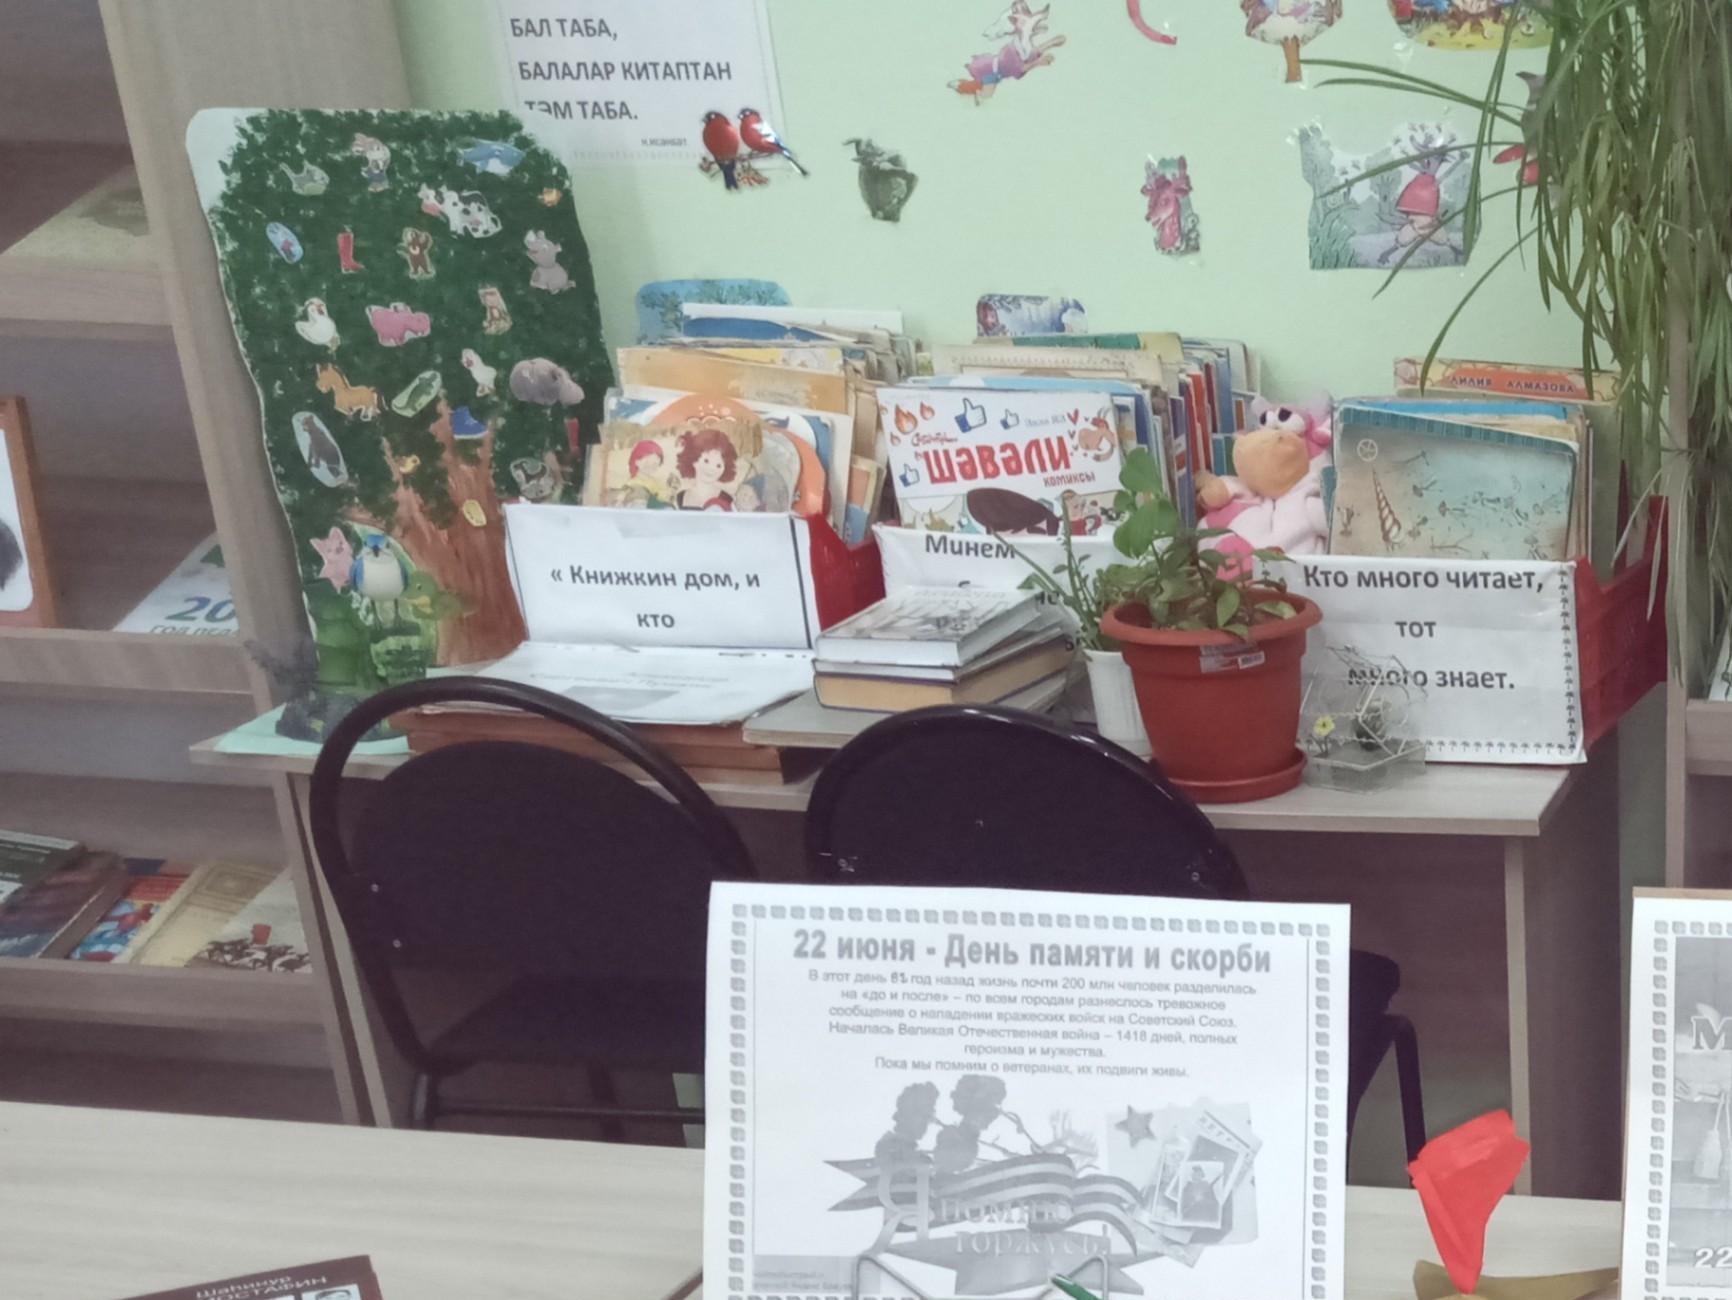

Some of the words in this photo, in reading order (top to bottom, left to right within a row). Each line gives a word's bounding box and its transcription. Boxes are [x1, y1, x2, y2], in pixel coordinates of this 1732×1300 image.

[510, 18, 551, 38] БАЛ
[556, 18, 618, 41] ТАБА,
[518, 62, 615, 81] БАЛАЛАР
[622, 62, 732, 81] КИТАПТАН
[576, 100, 638, 120] ТАБА.
[925, 534, 1016, 560] Минем
[569, 565, 676, 588] Книжкин
[684, 571, 740, 591] дом,
[746, 573, 761, 588] и
[1303, 564, 1348, 589] Кто
[1357, 569, 1439, 589] много
[1446, 570, 1544, 593] читает,
[636, 613, 675, 629] кто
[1395, 619, 1436, 638] тот
[1435, 669, 1515, 690] знает.
[793, 929, 827, 959] 22
[837, 936, 915, 962] июня
[944, 932, 1019, 968] День
[1029, 942, 1134, 971] памяти
[1145, 946, 1160, 970] и
[1171, 943, 1271, 978] скорби
[808, 969, 819, 981] В
[822, 971, 850, 983] этот
[854, 972, 886, 986] день
[911, 974, 932, 988] год
[935, 975, 975, 990] назад
[978, 976, 1018, 989] жизнь
[1021, 977, 1058, 989] почти
[1062, 977, 1085, 991] 200
[1089, 979, 1115, 991] млн
[1118, 980, 1170, 993] человек
[1174, 981, 1257, 996] разделилась
[829, 1006, 904, 1020] сообщение
[909, 1008, 917, 1018] о
[921, 1008, 992, 1022] нападении
[996, 1010, 1064, 1024] вражеских
[1069, 1012, 1105, 1025] войск
[1109, 1014, 1124, 1025] на
[1128, 1012, 1195, 1028] Советский
[1199, 1014, 1237, 1028] Союз.
[829, 1021, 894, 1036] Началась
[898, 1023, 954, 1037] Великая
[958, 1025, 1058, 1040] Отечественная
[1062, 1028, 1100, 1041] война
[1117, 1029, 1147, 1043] 1418
[1150, 1031, 1185, 1045] дней,
[1189, 1033, 1237, 1046] полных
[875, 1057, 908, 1071] Пока
[911, 1059, 932, 1071] мы
[935, 1060, 987, 1072] помним
[991, 1062, 999, 1073] о
[1002, 1062, 1073, 1076] ветеранах,
[1077, 1064, 1092, 1076] их
[1096, 1065, 1148, 1078] подвиги
[1152, 1066, 1189, 1078] живы.
